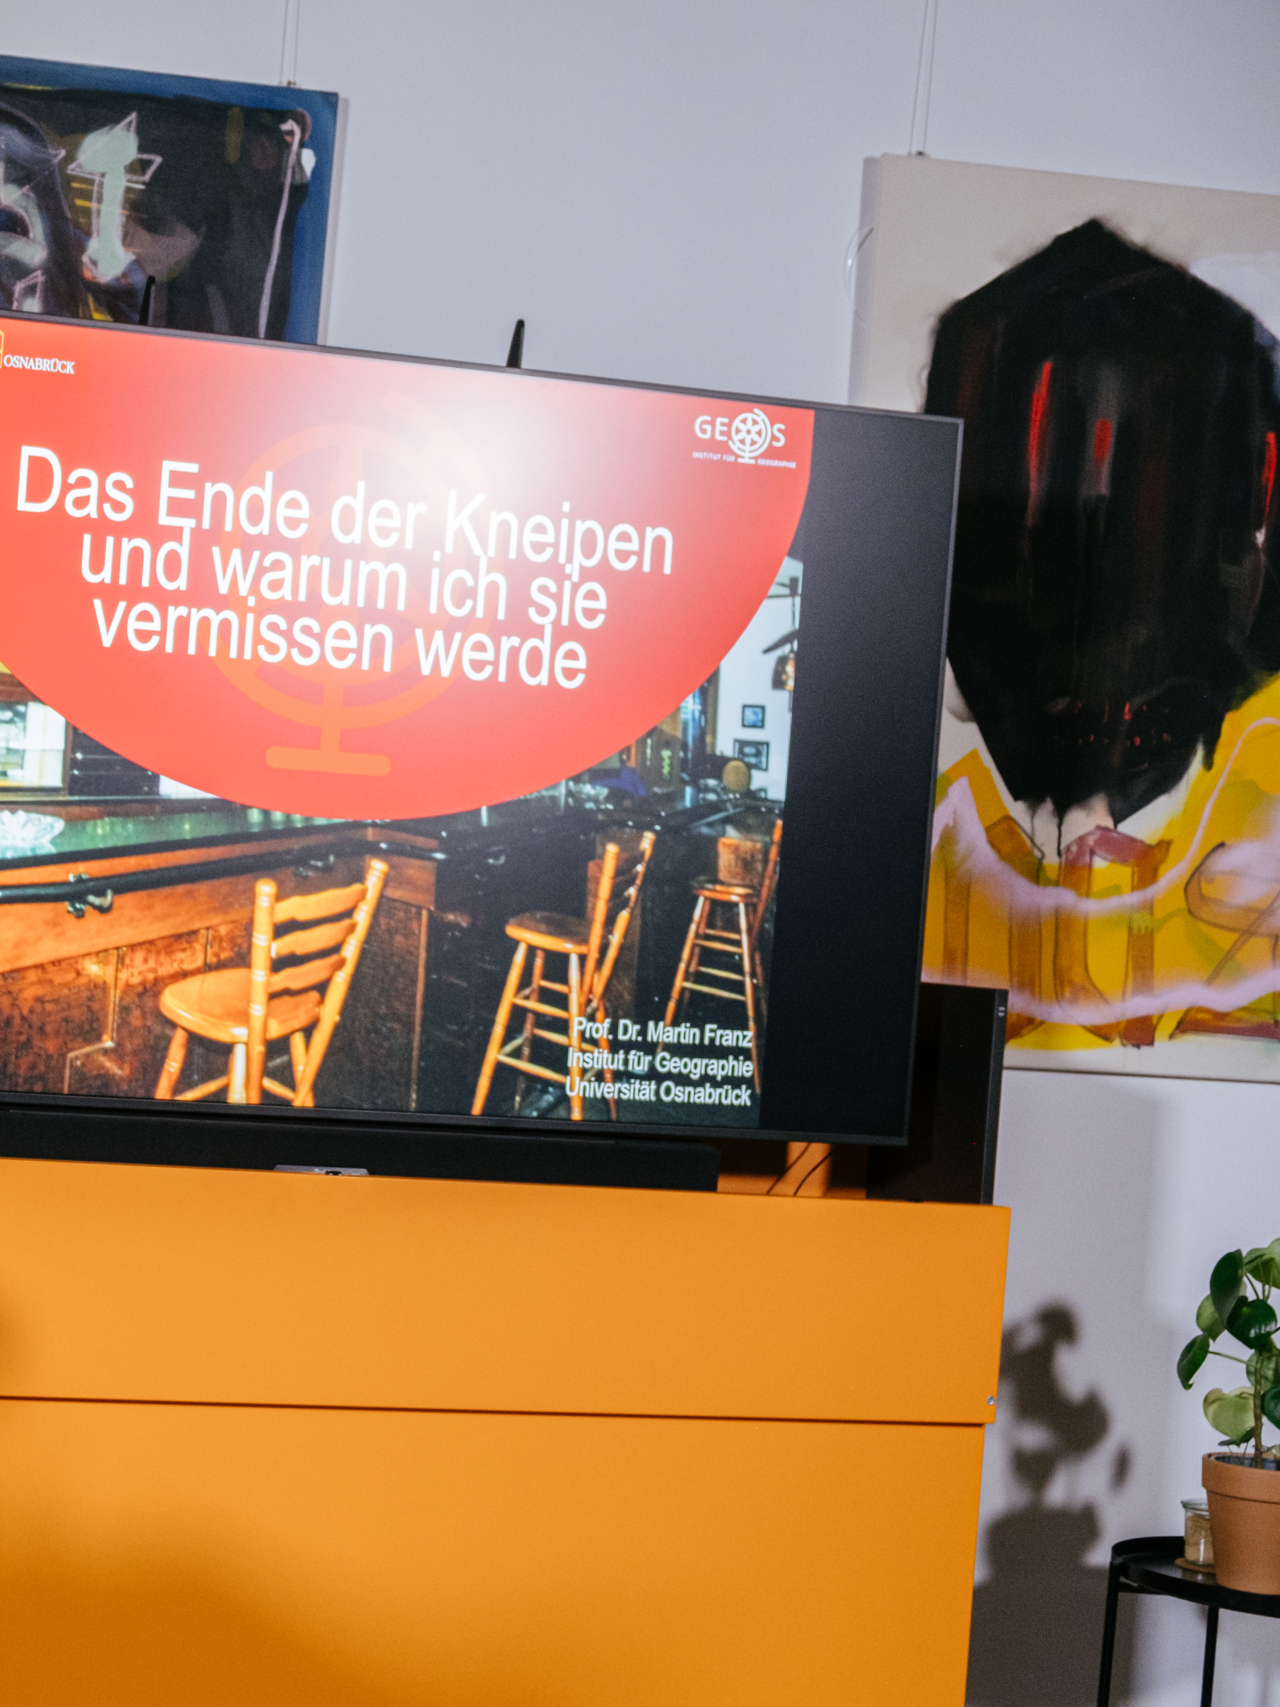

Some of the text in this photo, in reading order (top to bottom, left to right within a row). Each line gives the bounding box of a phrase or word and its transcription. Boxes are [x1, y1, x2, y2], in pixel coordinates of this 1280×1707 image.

[3, 354, 75, 375] OSNABRÜCK
[17, 445, 673, 582] Das Ende der Kneipen
[80, 527, 607, 630] und warum ich sie
[92, 597, 586, 690] vermissen werde
[572, 1016, 754, 1047] Prof. Dr. Martin Franz
[567, 1047, 754, 1081] Institut für Geographie
[565, 1076, 752, 1106] Universität Osnabrück
